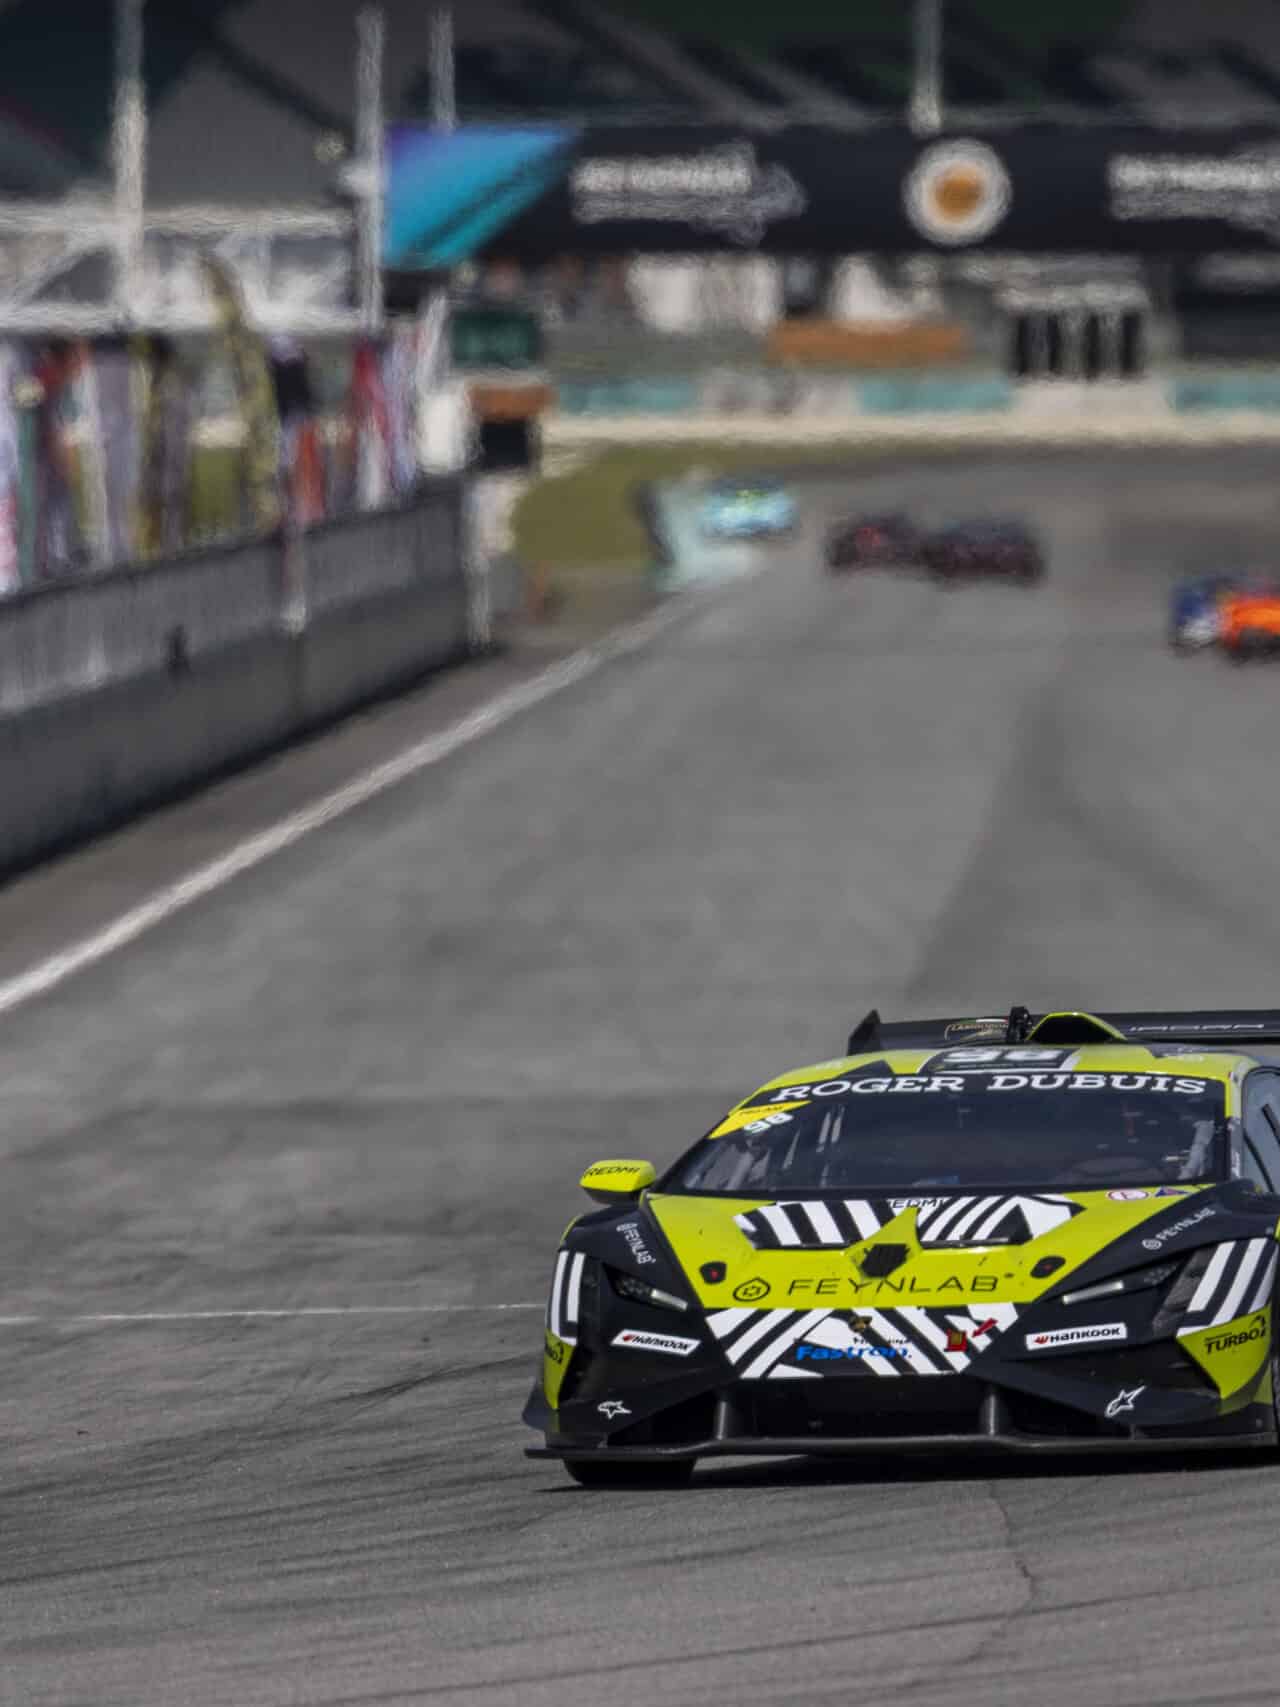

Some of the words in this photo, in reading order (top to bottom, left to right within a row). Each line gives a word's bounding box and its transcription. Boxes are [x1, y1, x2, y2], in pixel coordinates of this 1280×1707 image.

[770, 1076, 965, 1102] ROGER
[986, 1073, 1206, 1093] DUBUIS
[786, 1273, 1000, 1297] FEYNLAB
